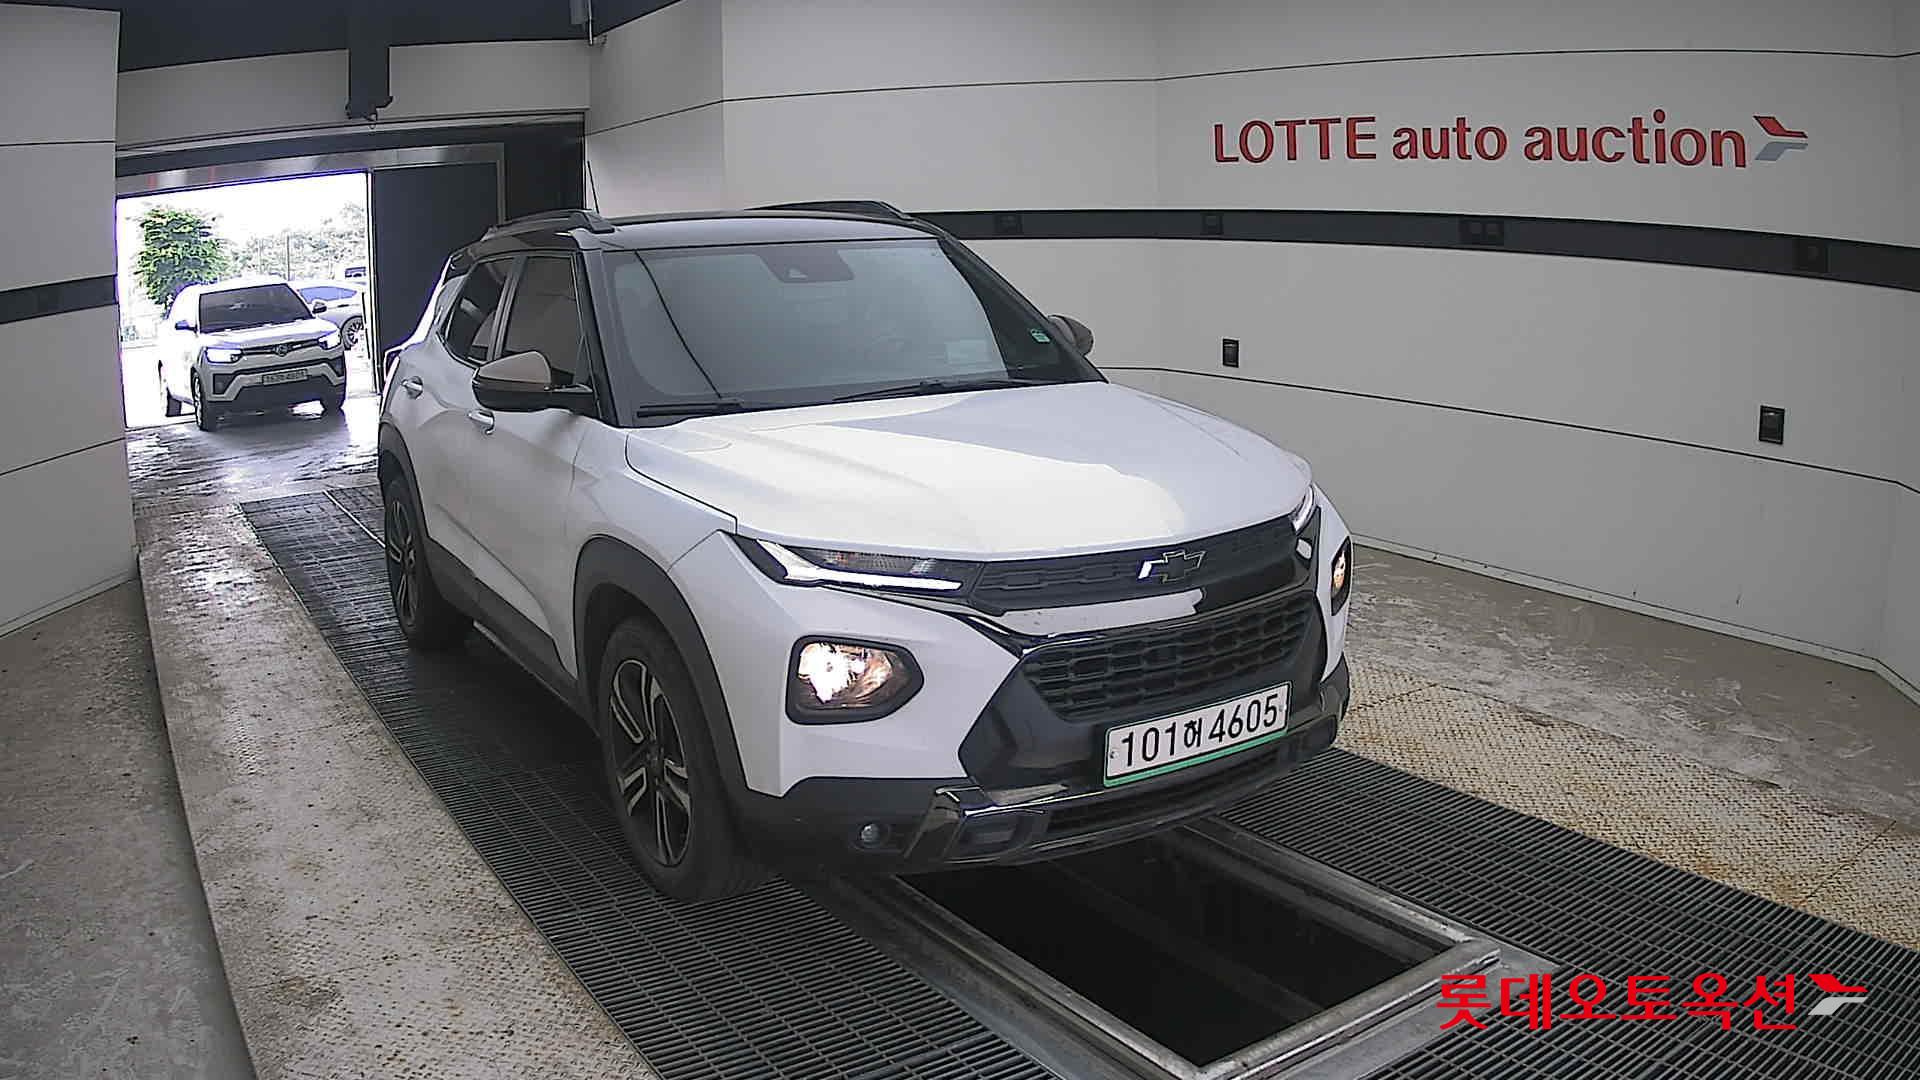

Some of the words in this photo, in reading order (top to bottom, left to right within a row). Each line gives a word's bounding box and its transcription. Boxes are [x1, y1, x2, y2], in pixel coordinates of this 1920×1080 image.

[1213, 116, 1377, 164] LOTTE
[1392, 116, 1507, 161] auto
[1523, 108, 1747, 168] auction
